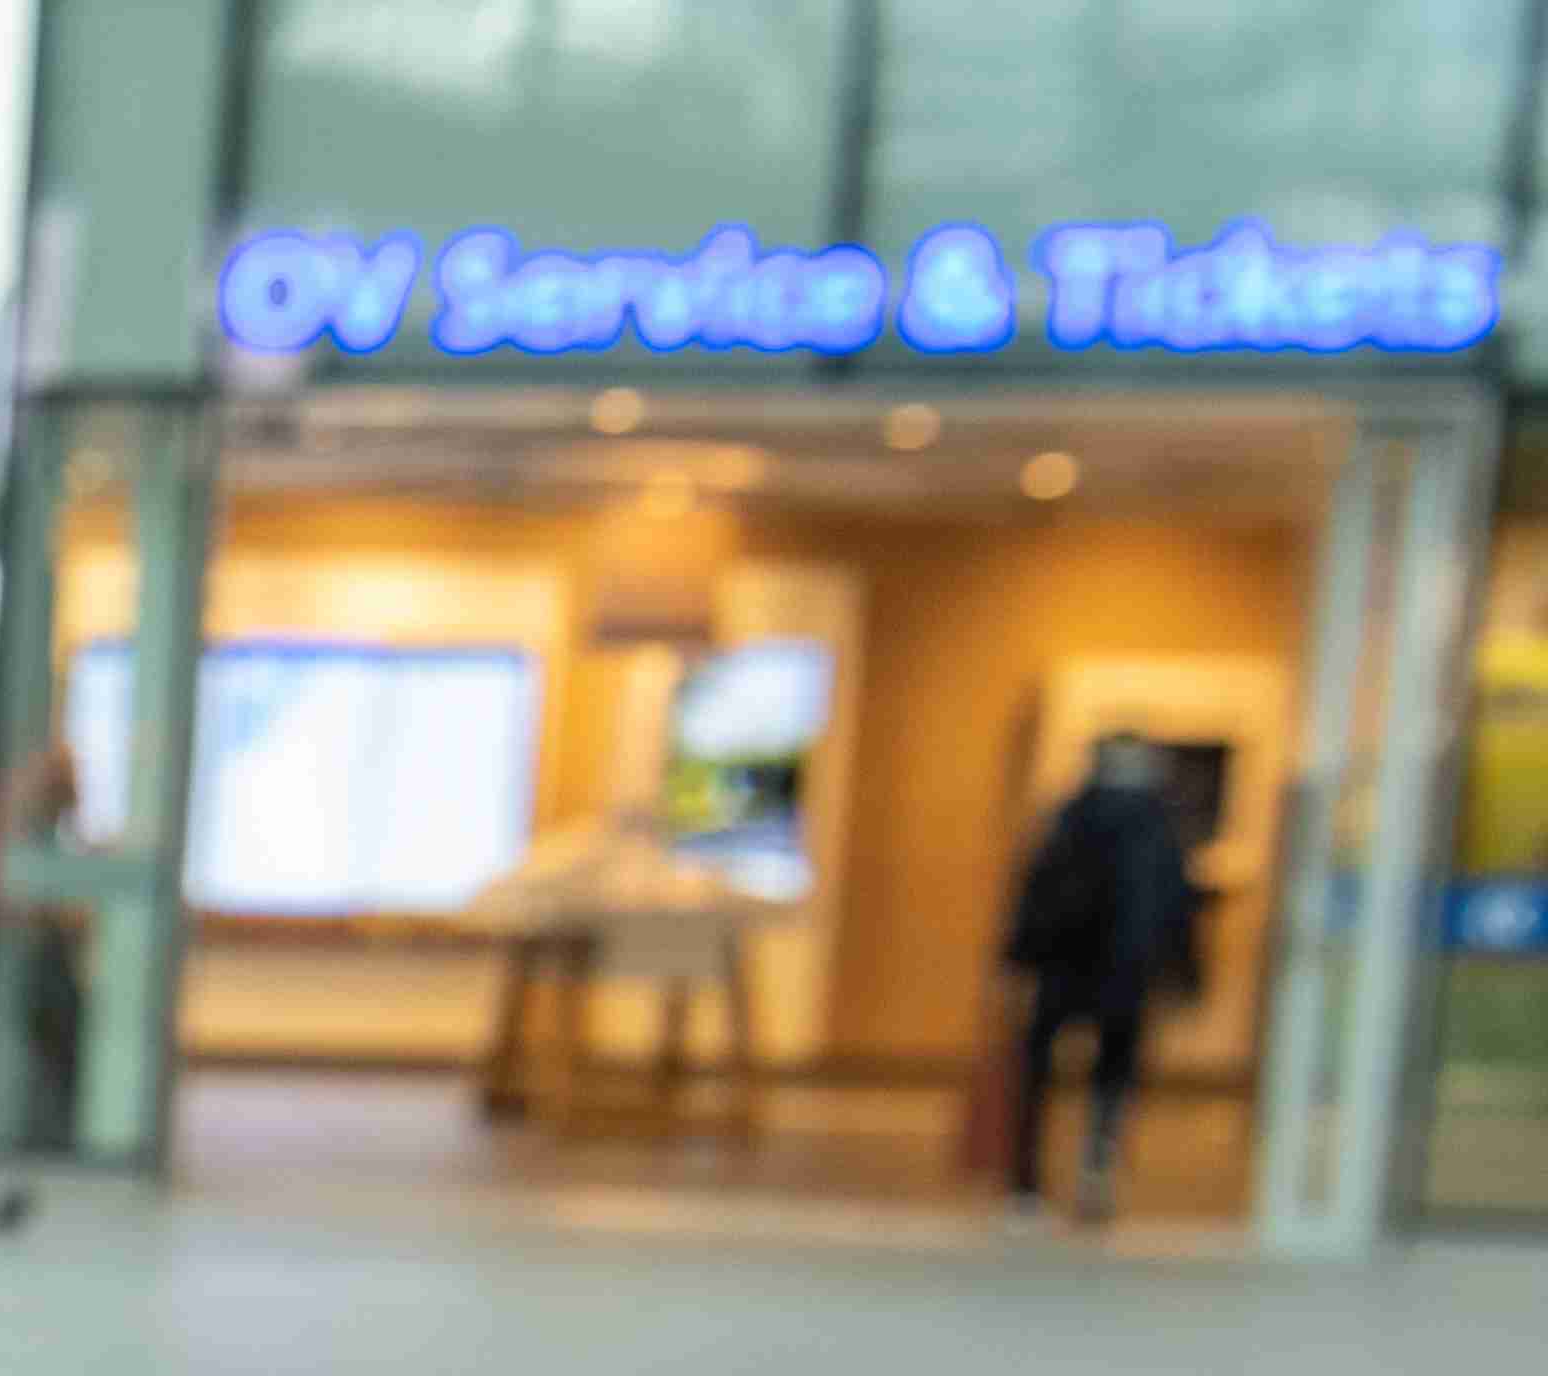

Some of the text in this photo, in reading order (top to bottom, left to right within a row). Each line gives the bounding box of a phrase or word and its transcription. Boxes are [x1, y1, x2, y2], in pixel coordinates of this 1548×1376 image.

[221, 218, 1502, 354] OV Service & Tickets
